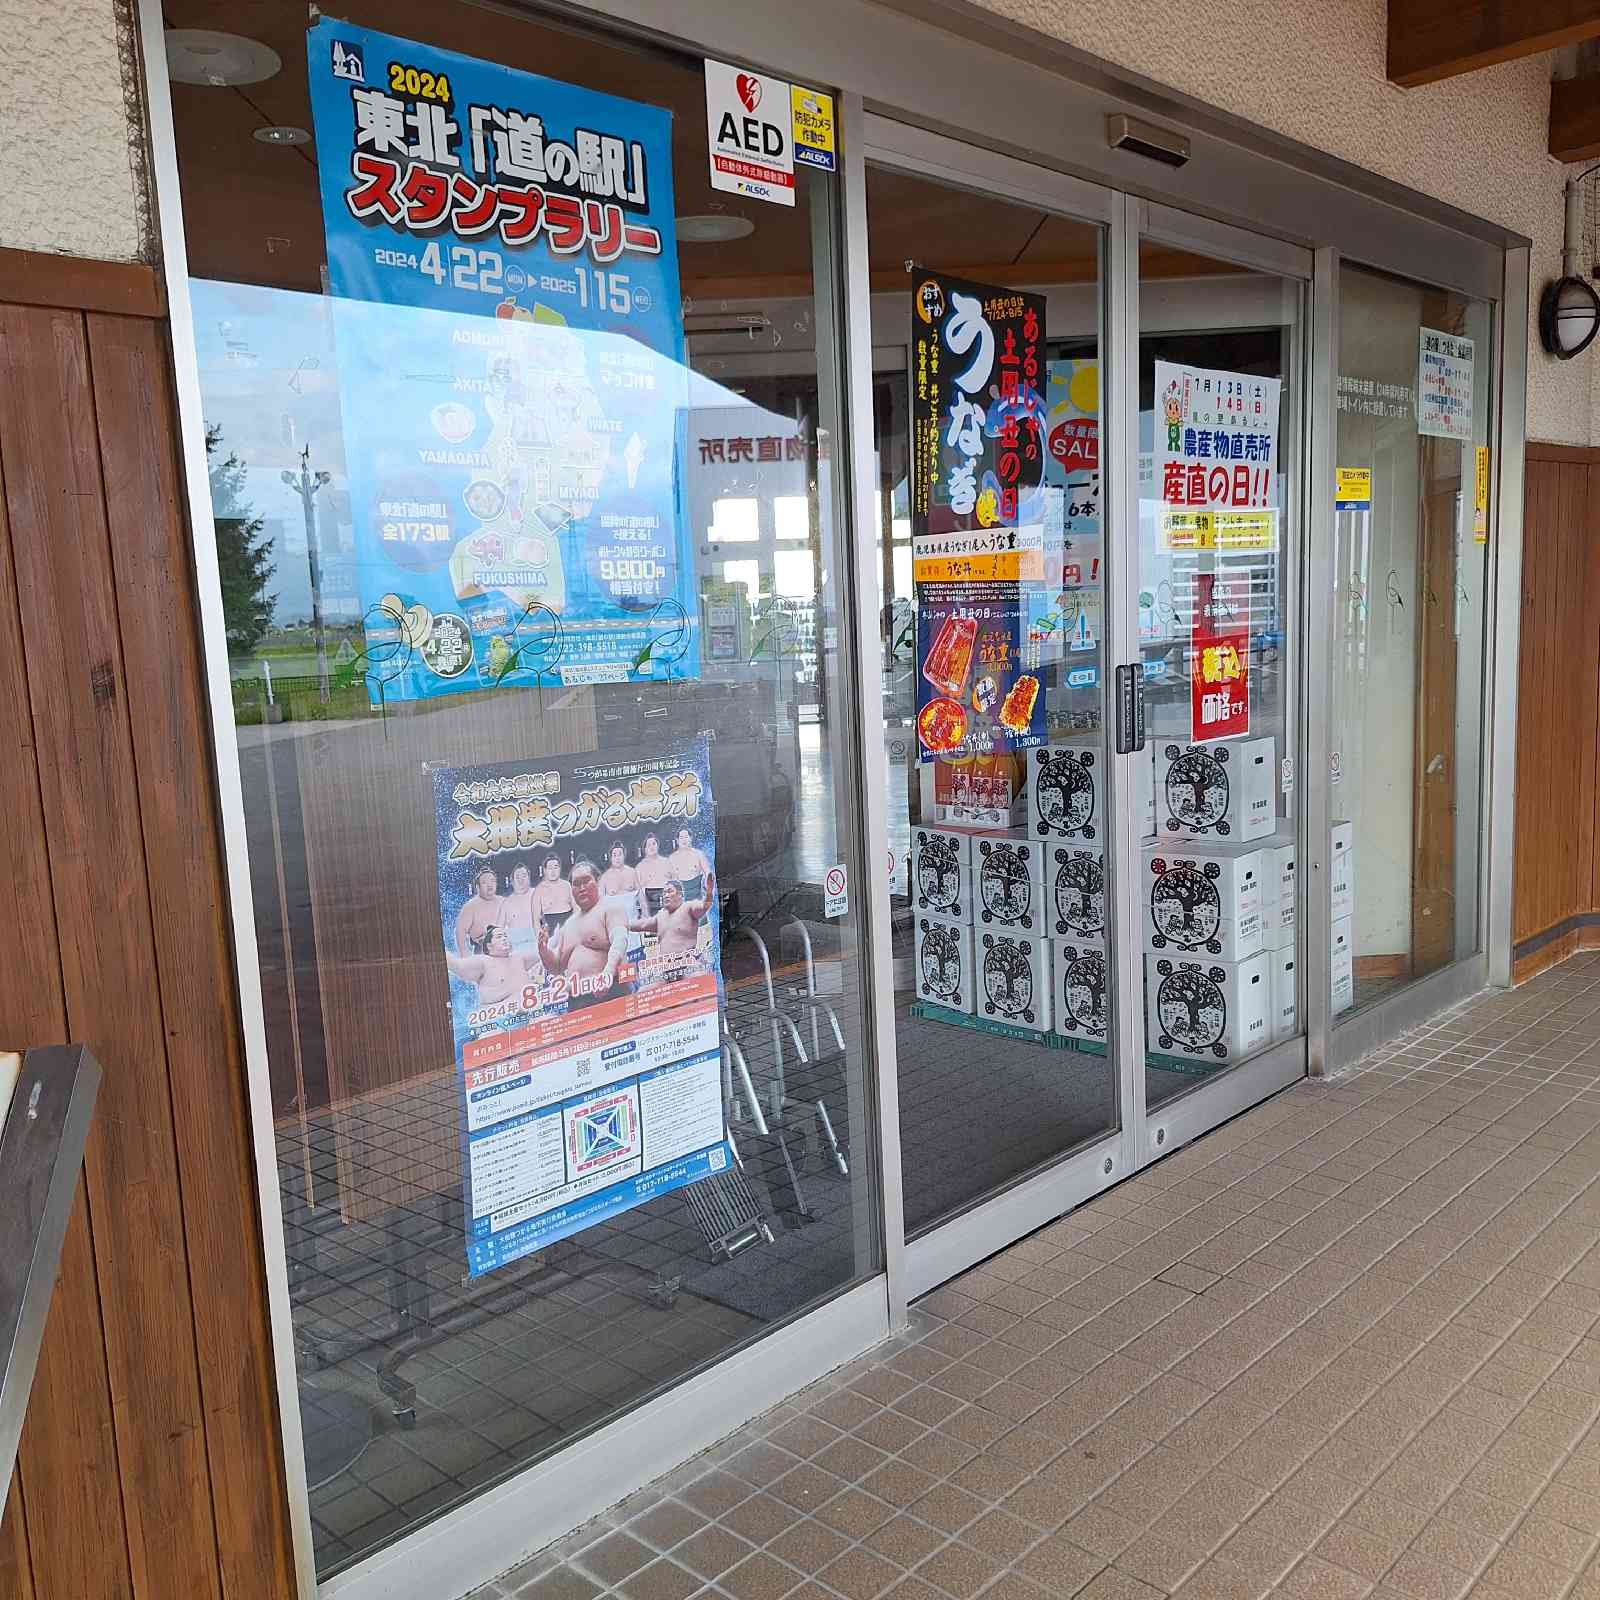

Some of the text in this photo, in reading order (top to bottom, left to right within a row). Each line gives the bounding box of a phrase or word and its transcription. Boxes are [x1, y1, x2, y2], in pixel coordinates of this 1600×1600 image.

[389, 64, 450, 103] 2024
[353, 88, 647, 205] 東北「道の駅」
[717, 111, 784, 157] AED
[347, 152, 662, 262] スタンプラリー
[374, 248, 418, 269] 2024
[539, 276, 577, 294] 2025
[1000, 327, 1023, 521] 土用丑の日
[1184, 427, 1272, 463] 農産物直売所
[1163, 460, 1270, 507] 産直の日!!
[473, 571, 547, 585] FUKUSHIMA
[449, 772, 702, 860] 大相撲つがる場所
